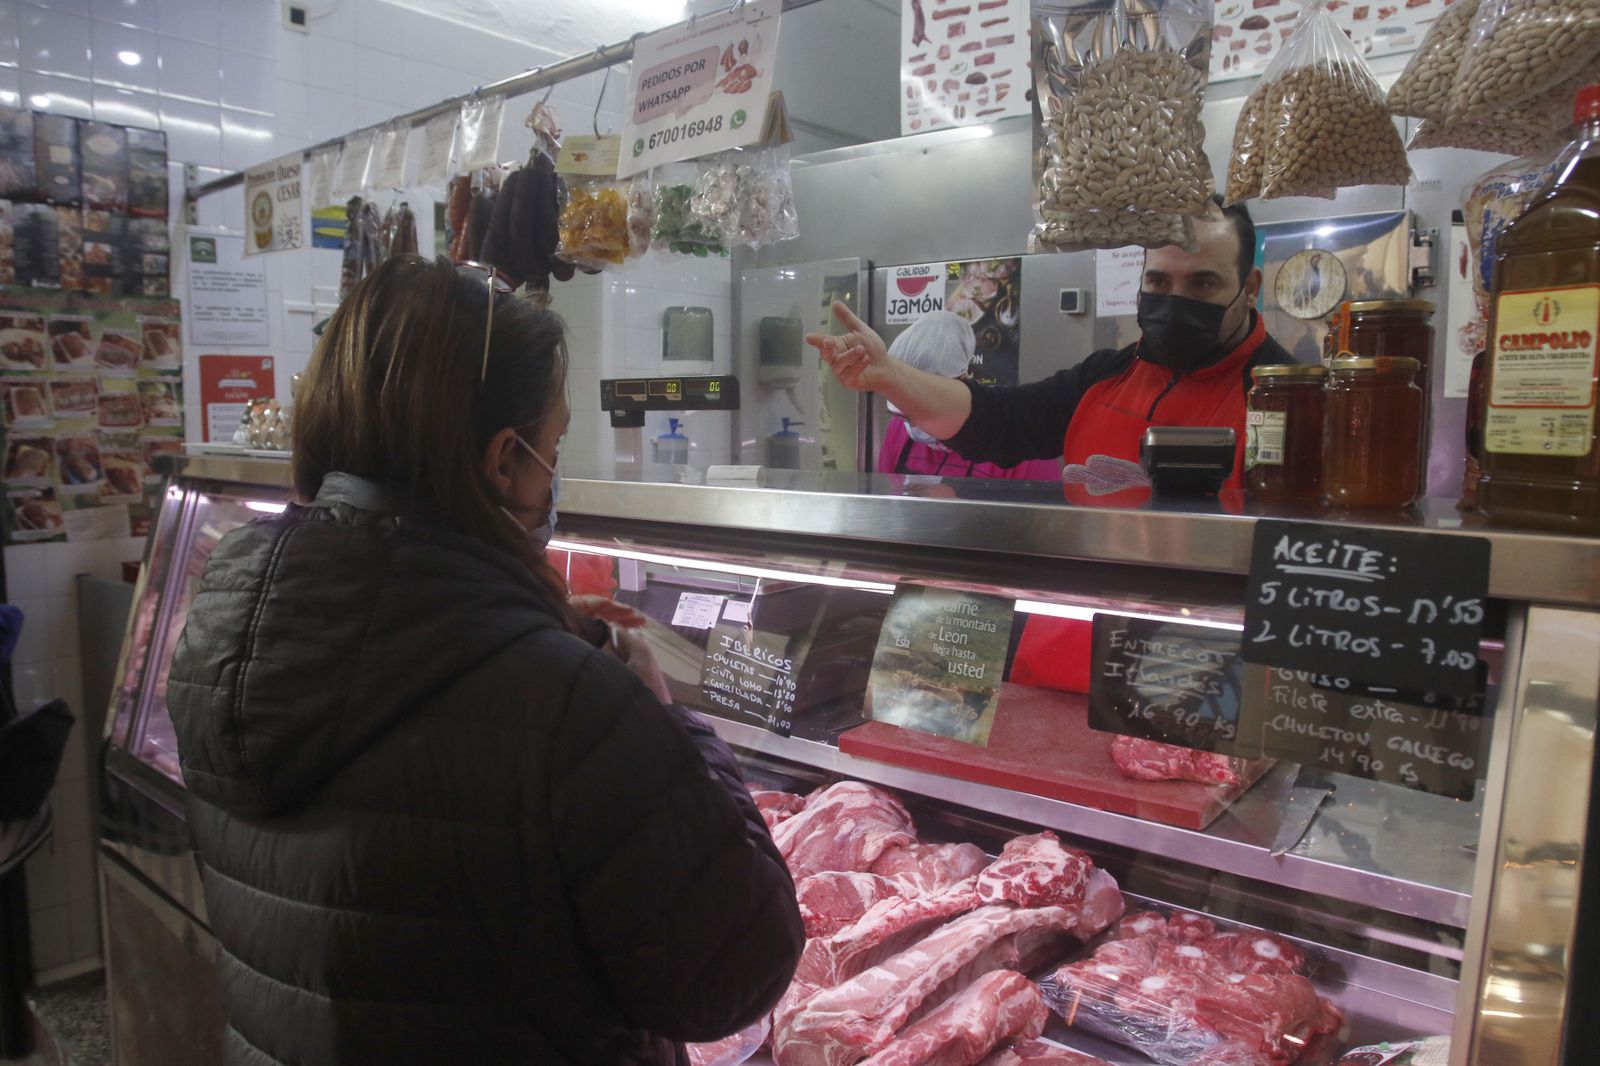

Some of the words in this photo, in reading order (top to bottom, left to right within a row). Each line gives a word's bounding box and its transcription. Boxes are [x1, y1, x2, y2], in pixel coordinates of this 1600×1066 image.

[641, 66, 682, 91] PEDIDOS
[683, 58, 706, 76] POR
[638, 85, 691, 113] WHATSAPP
[648, 115, 723, 150] 670016948
[1258, 581, 1282, 605] 5
[952, 617, 997, 633] montaña
[932, 642, 950, 657] llega
[951, 645, 976, 660] hasta
[1252, 620, 1277, 643] 2
[1420, 637, 1476, 670] 7.00
[947, 661, 986, 679] usted
[739, 677, 762, 692] LOMO
[1350, 699, 1404, 723] extra
[1386, 736, 1475, 770] GALLEGO
